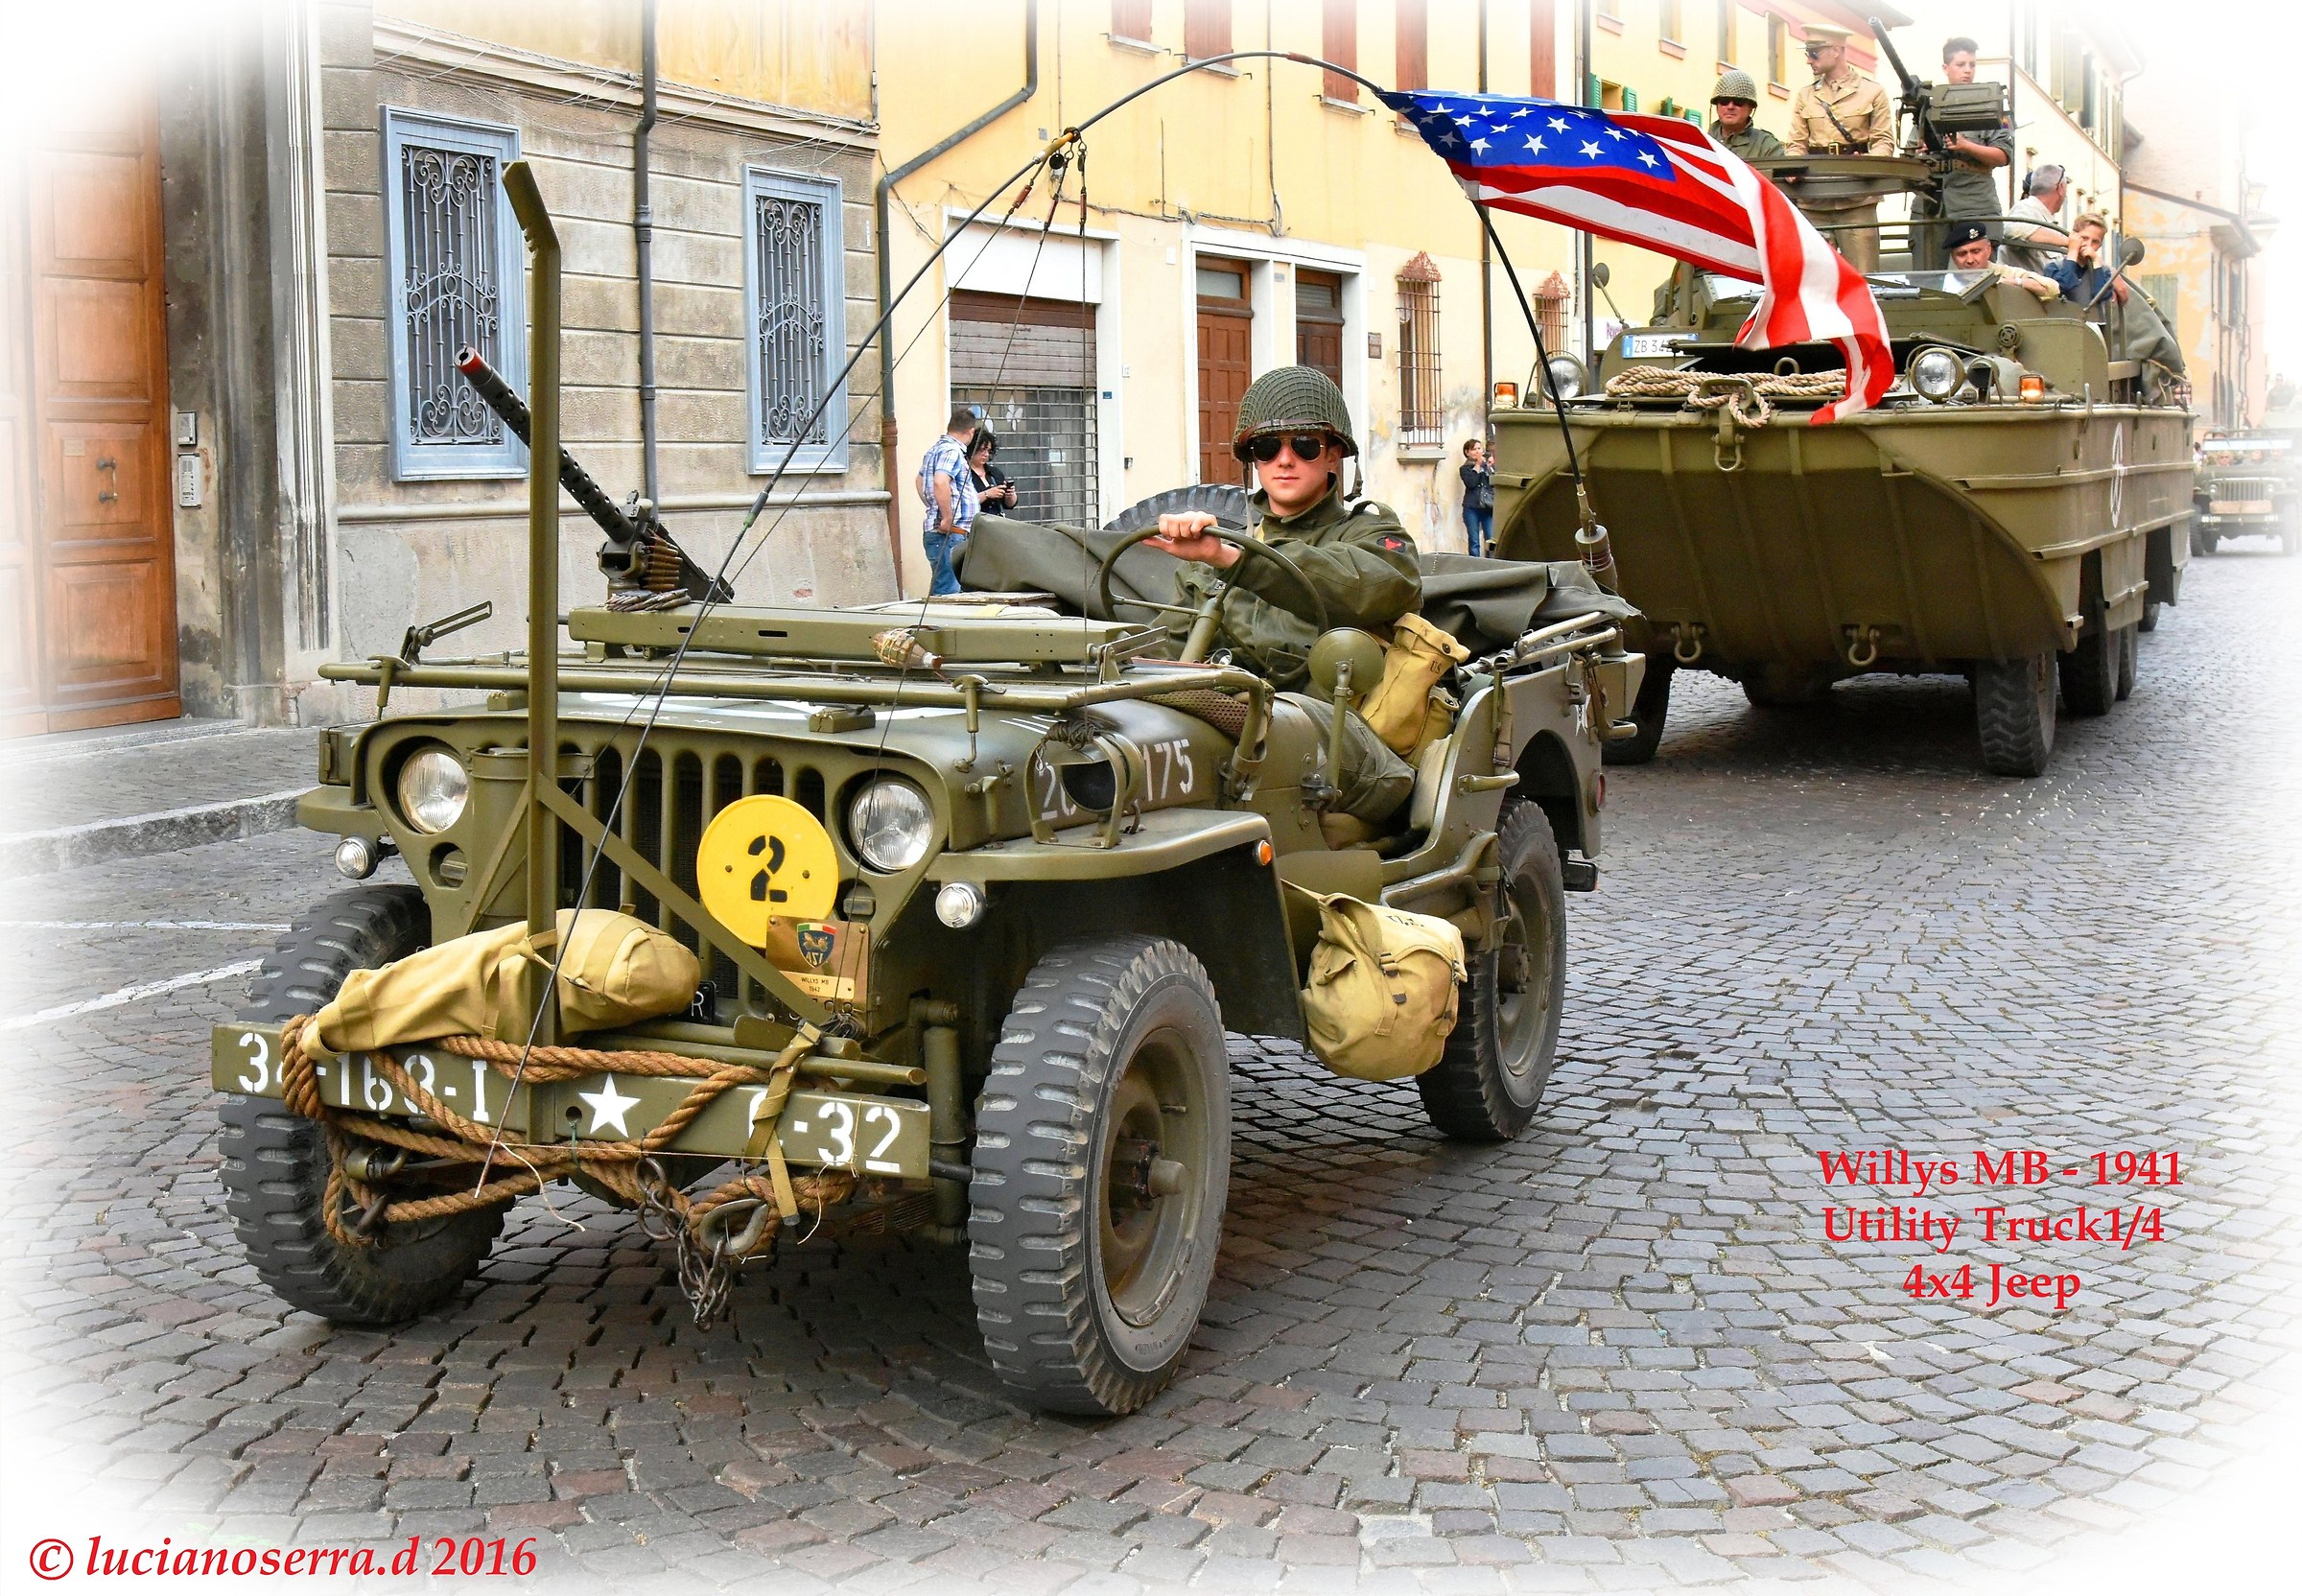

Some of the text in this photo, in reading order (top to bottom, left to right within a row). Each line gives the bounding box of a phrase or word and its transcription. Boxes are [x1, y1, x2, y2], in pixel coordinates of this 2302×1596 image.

[1634, 340, 1648, 354] ZB
[747, 834, 788, 904] 2
[809, 985, 821, 994] 1942
[238, 1031, 490, 1122] 3-168-I
